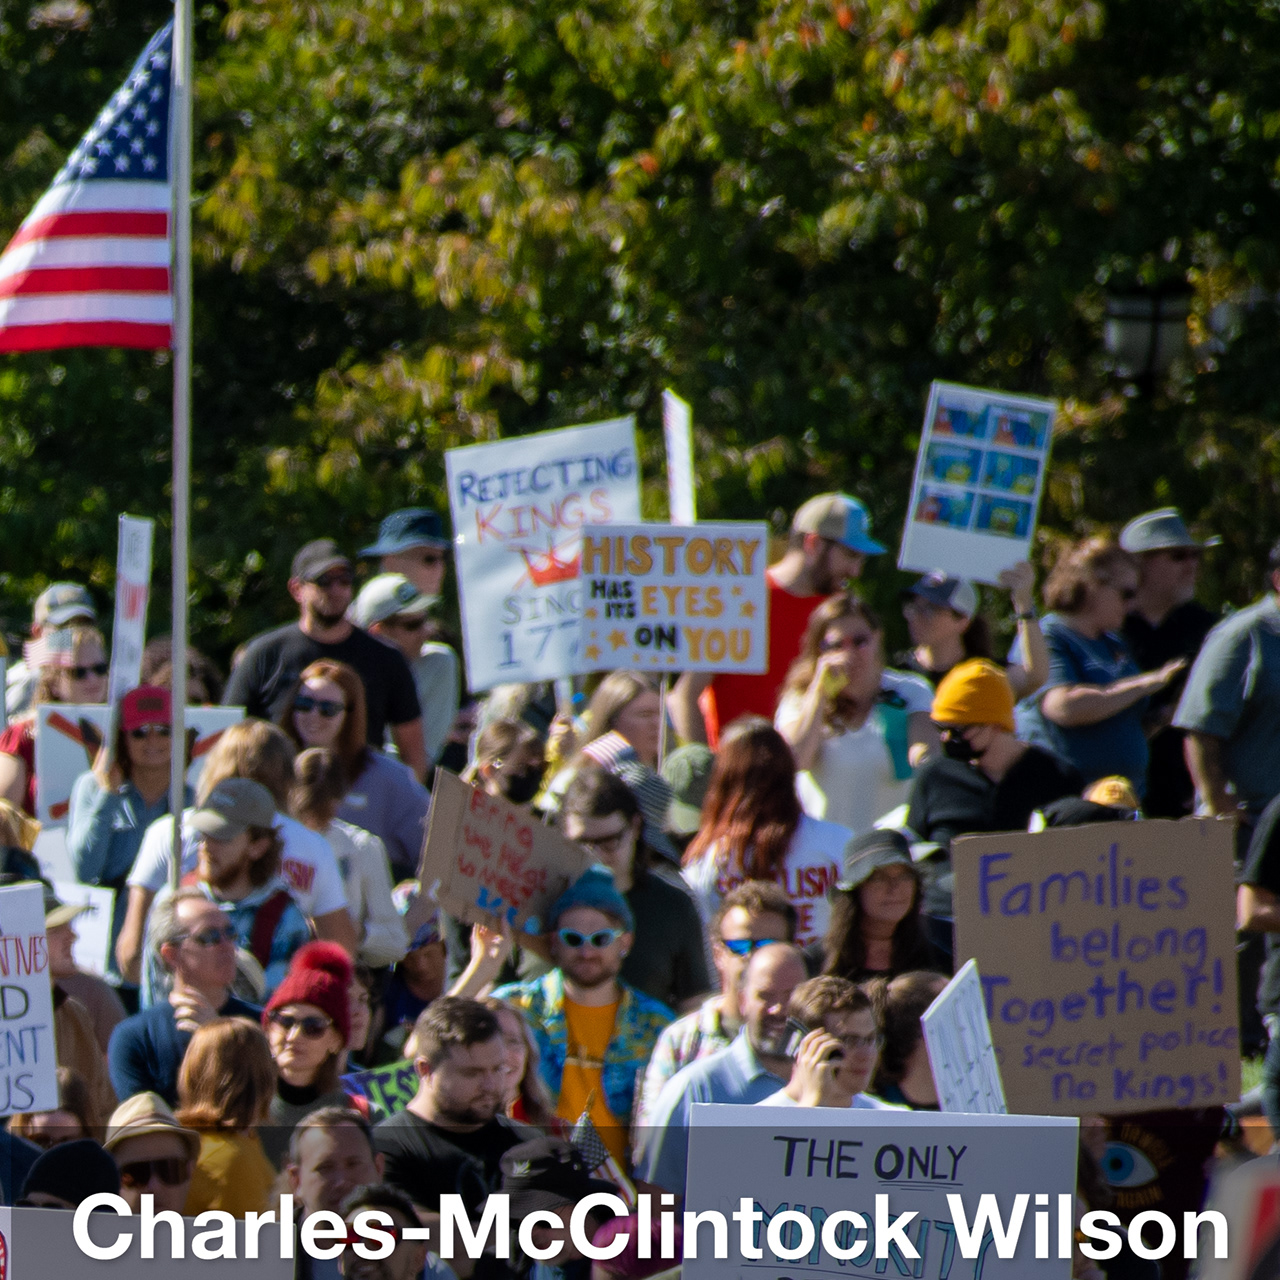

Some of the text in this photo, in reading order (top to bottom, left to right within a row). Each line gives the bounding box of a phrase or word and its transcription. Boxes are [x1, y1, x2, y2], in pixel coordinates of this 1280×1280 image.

[459, 449, 634, 508] REJECTING
[475, 489, 613, 543] KINGS
[583, 535, 760, 576] HISTORY
[591, 579, 633, 600] HAS
[604, 603, 636, 620] ITS
[642, 585, 724, 618] EYES
[635, 624, 752, 662] ON YOU
[978, 842, 1189, 917] Families
[1051, 921, 1208, 971] belong
[1022, 1033, 1125, 1070] secret
[1141, 1021, 1239, 1063] police
[773, 1135, 968, 1181] THE ONLY
